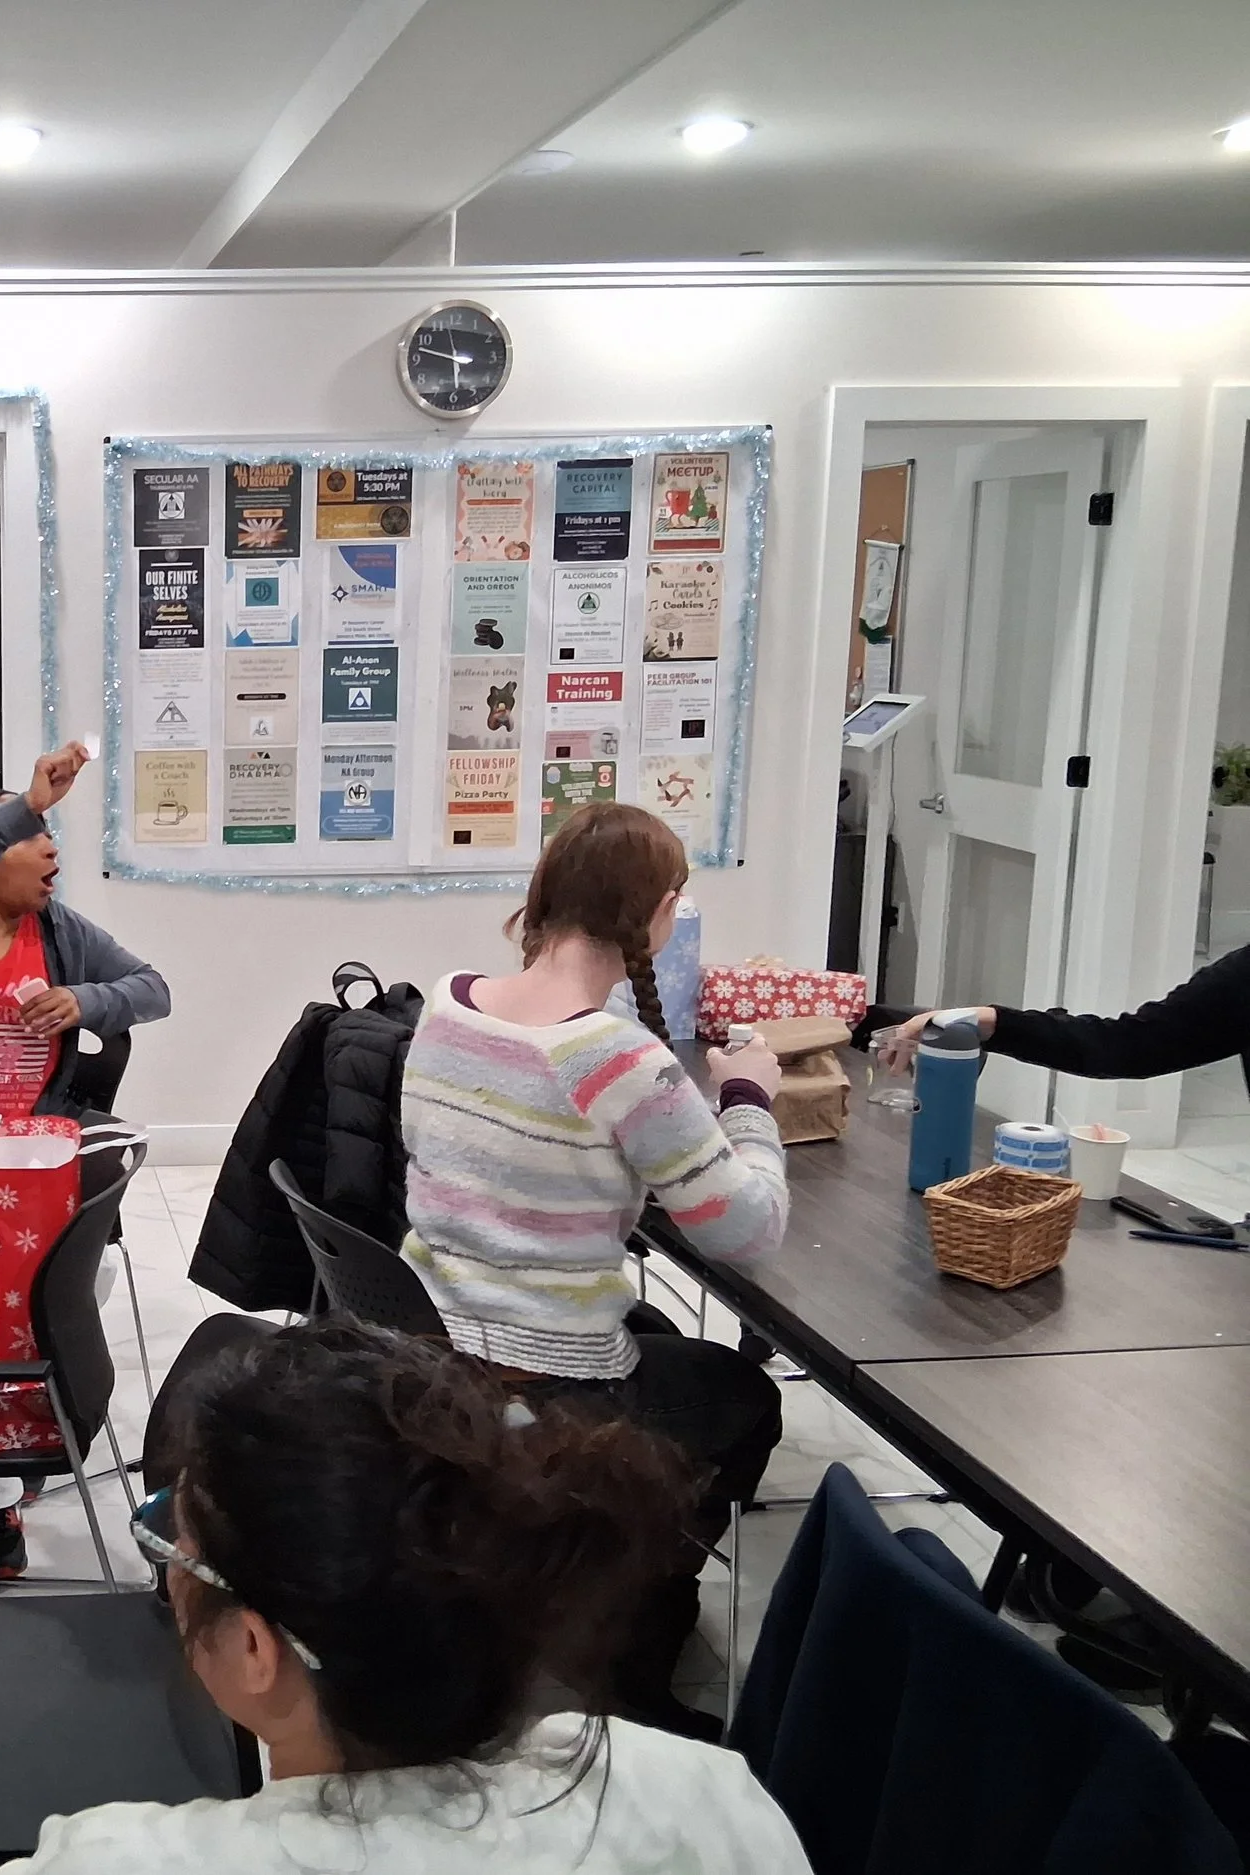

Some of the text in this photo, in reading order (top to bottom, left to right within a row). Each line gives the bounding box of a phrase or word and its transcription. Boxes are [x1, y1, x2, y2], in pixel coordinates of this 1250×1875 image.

[450, 313, 462, 325] 12
[432, 320, 444, 332] 11
[418, 334, 432, 346] 10
[485, 332, 492, 343] 2
[412, 354, 420, 366] 9
[490, 351, 498, 364] 3
[417, 373, 426, 385] 8
[432, 386, 440, 398] 7
[470, 385, 477, 396] 5
[449, 392, 458, 403] 6
[670, 457, 713, 465] VOLUNTEER
[357, 471, 408, 482] Tuesdays at
[667, 466, 714, 477] MEETUP
[144, 474, 199, 485] SECULAR AA
[237, 475, 290, 487] TO RECOVERY
[566, 473, 623, 482] RECOVERY
[363, 482, 401, 492] 5:30 PM
[572, 484, 616, 494] CAPITAL
[565, 516, 593, 525] Fridays
[594, 516, 602, 524] at
[145, 570, 199, 586] OUR FINITE
[562, 572, 618, 580] ALCOHOLICOS
[568, 582, 612, 590] ANONIMOS
[660, 580, 706, 588] Karaoke
[152, 586, 188, 600] SELVES
[663, 600, 704, 610] Cookies
[342, 656, 380, 664] Al-Anon
[330, 667, 391, 678] Family Group
[562, 676, 609, 686] Narcan
[556, 688, 613, 700] Training
[146, 760, 196, 770] Coffee with
[324, 754, 393, 765] Monday Afternoon
[450, 758, 516, 770] FELLOWSHIP
[230, 764, 280, 772] RECOVERY
[341, 768, 375, 777] NA Group
[160, 770, 190, 780] Coach
[464, 773, 502, 785] FRIDAY
[482, 790, 509, 799] Party
